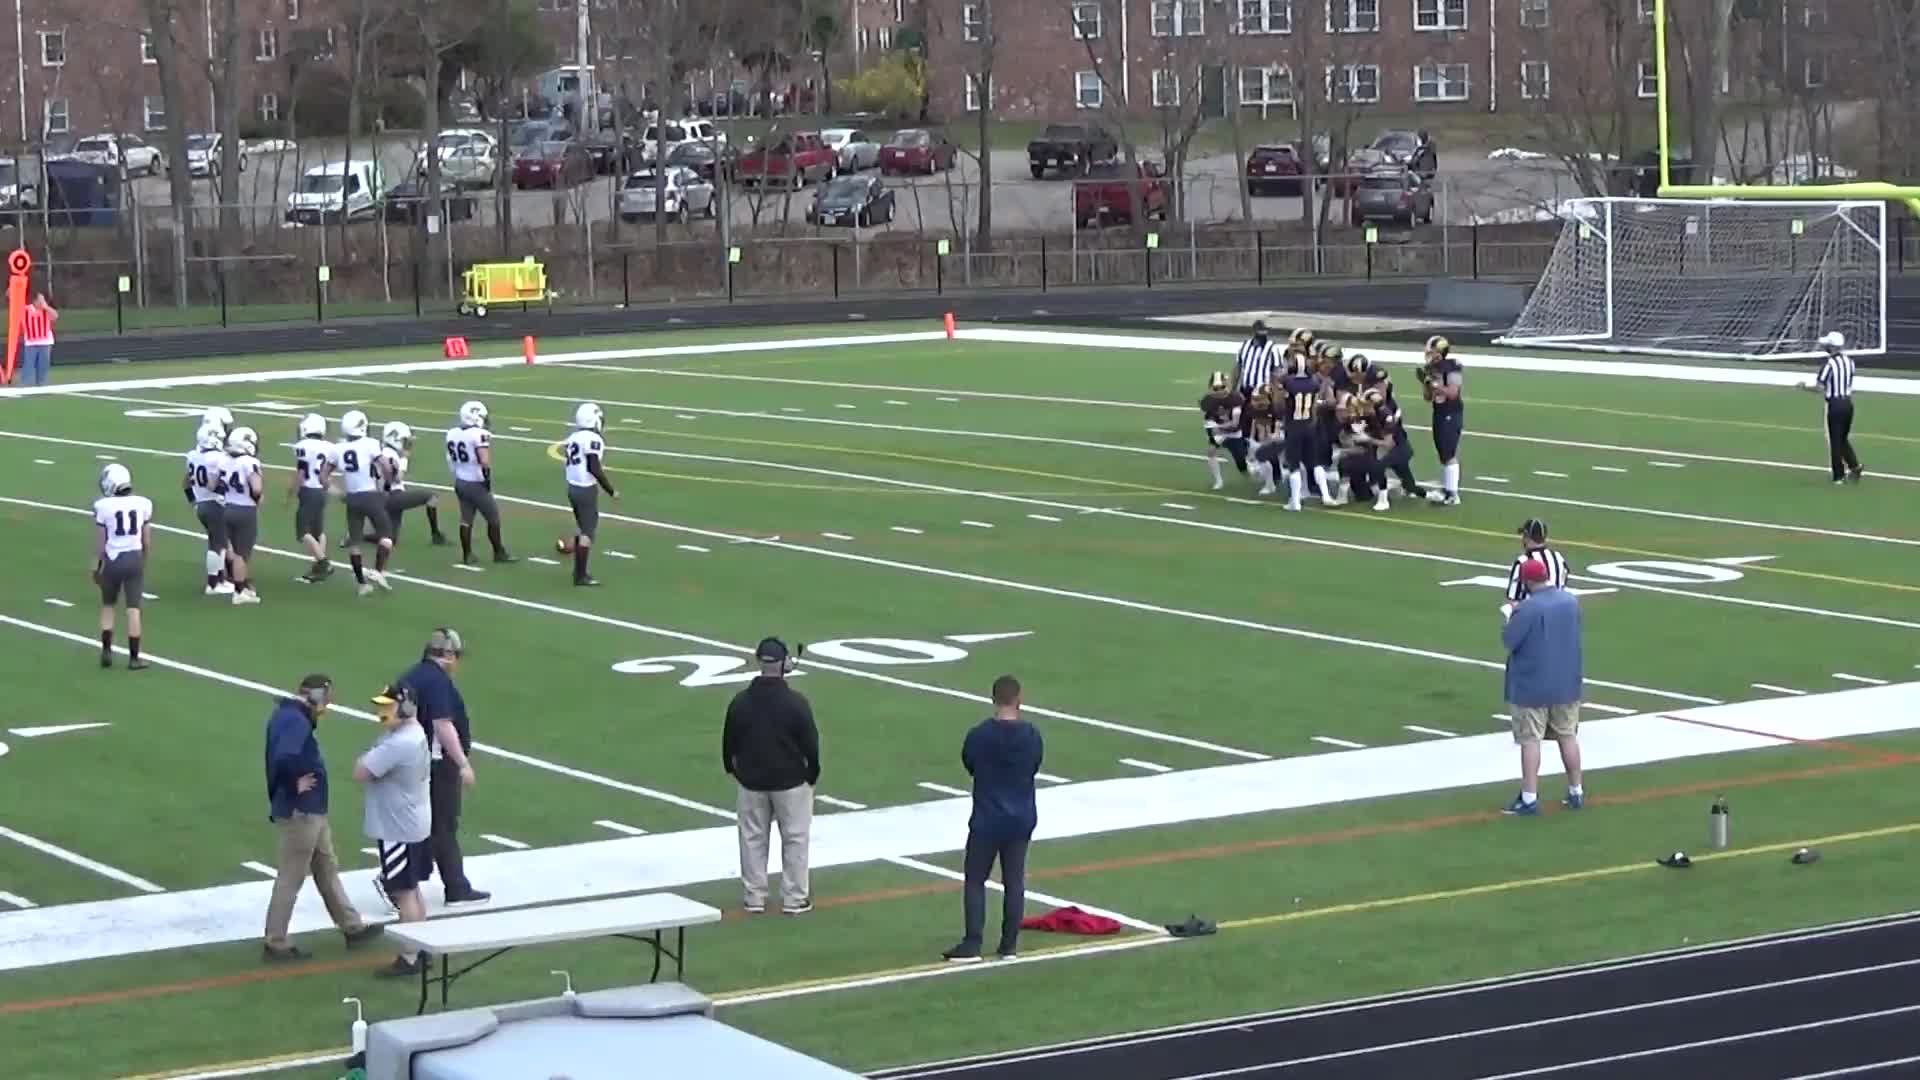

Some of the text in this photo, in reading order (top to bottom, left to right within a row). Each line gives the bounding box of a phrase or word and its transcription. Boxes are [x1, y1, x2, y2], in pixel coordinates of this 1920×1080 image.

[1293, 392, 1312, 420] 11
[344, 450, 359, 473] 9
[189, 463, 208, 488] 20
[115, 510, 138, 536] 11
[612, 638, 969, 686] 20
